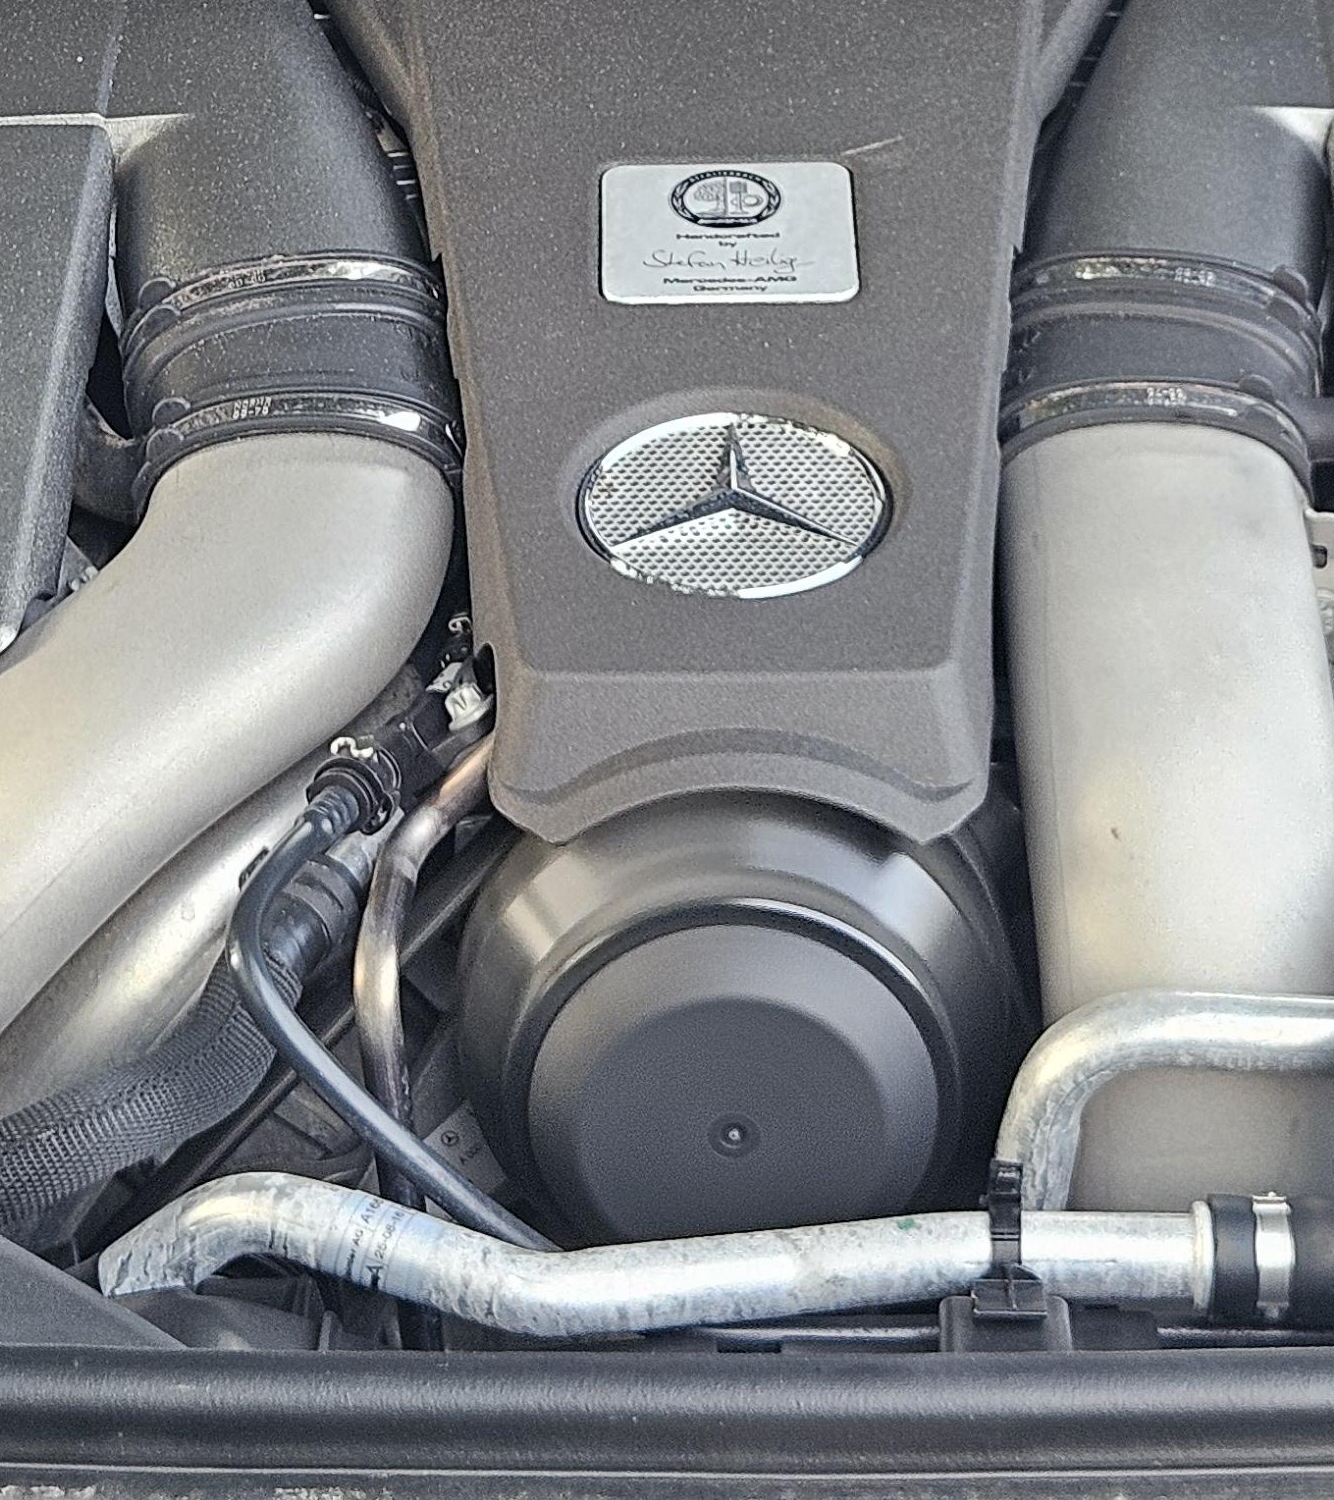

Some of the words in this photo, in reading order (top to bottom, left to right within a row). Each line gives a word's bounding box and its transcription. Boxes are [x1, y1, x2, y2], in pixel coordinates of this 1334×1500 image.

[675, 232, 781, 240] Handcrafted
[718, 240, 737, 248] by
[663, 275, 798, 284] Mercedes-AMG
[692, 284, 768, 293] Germany
